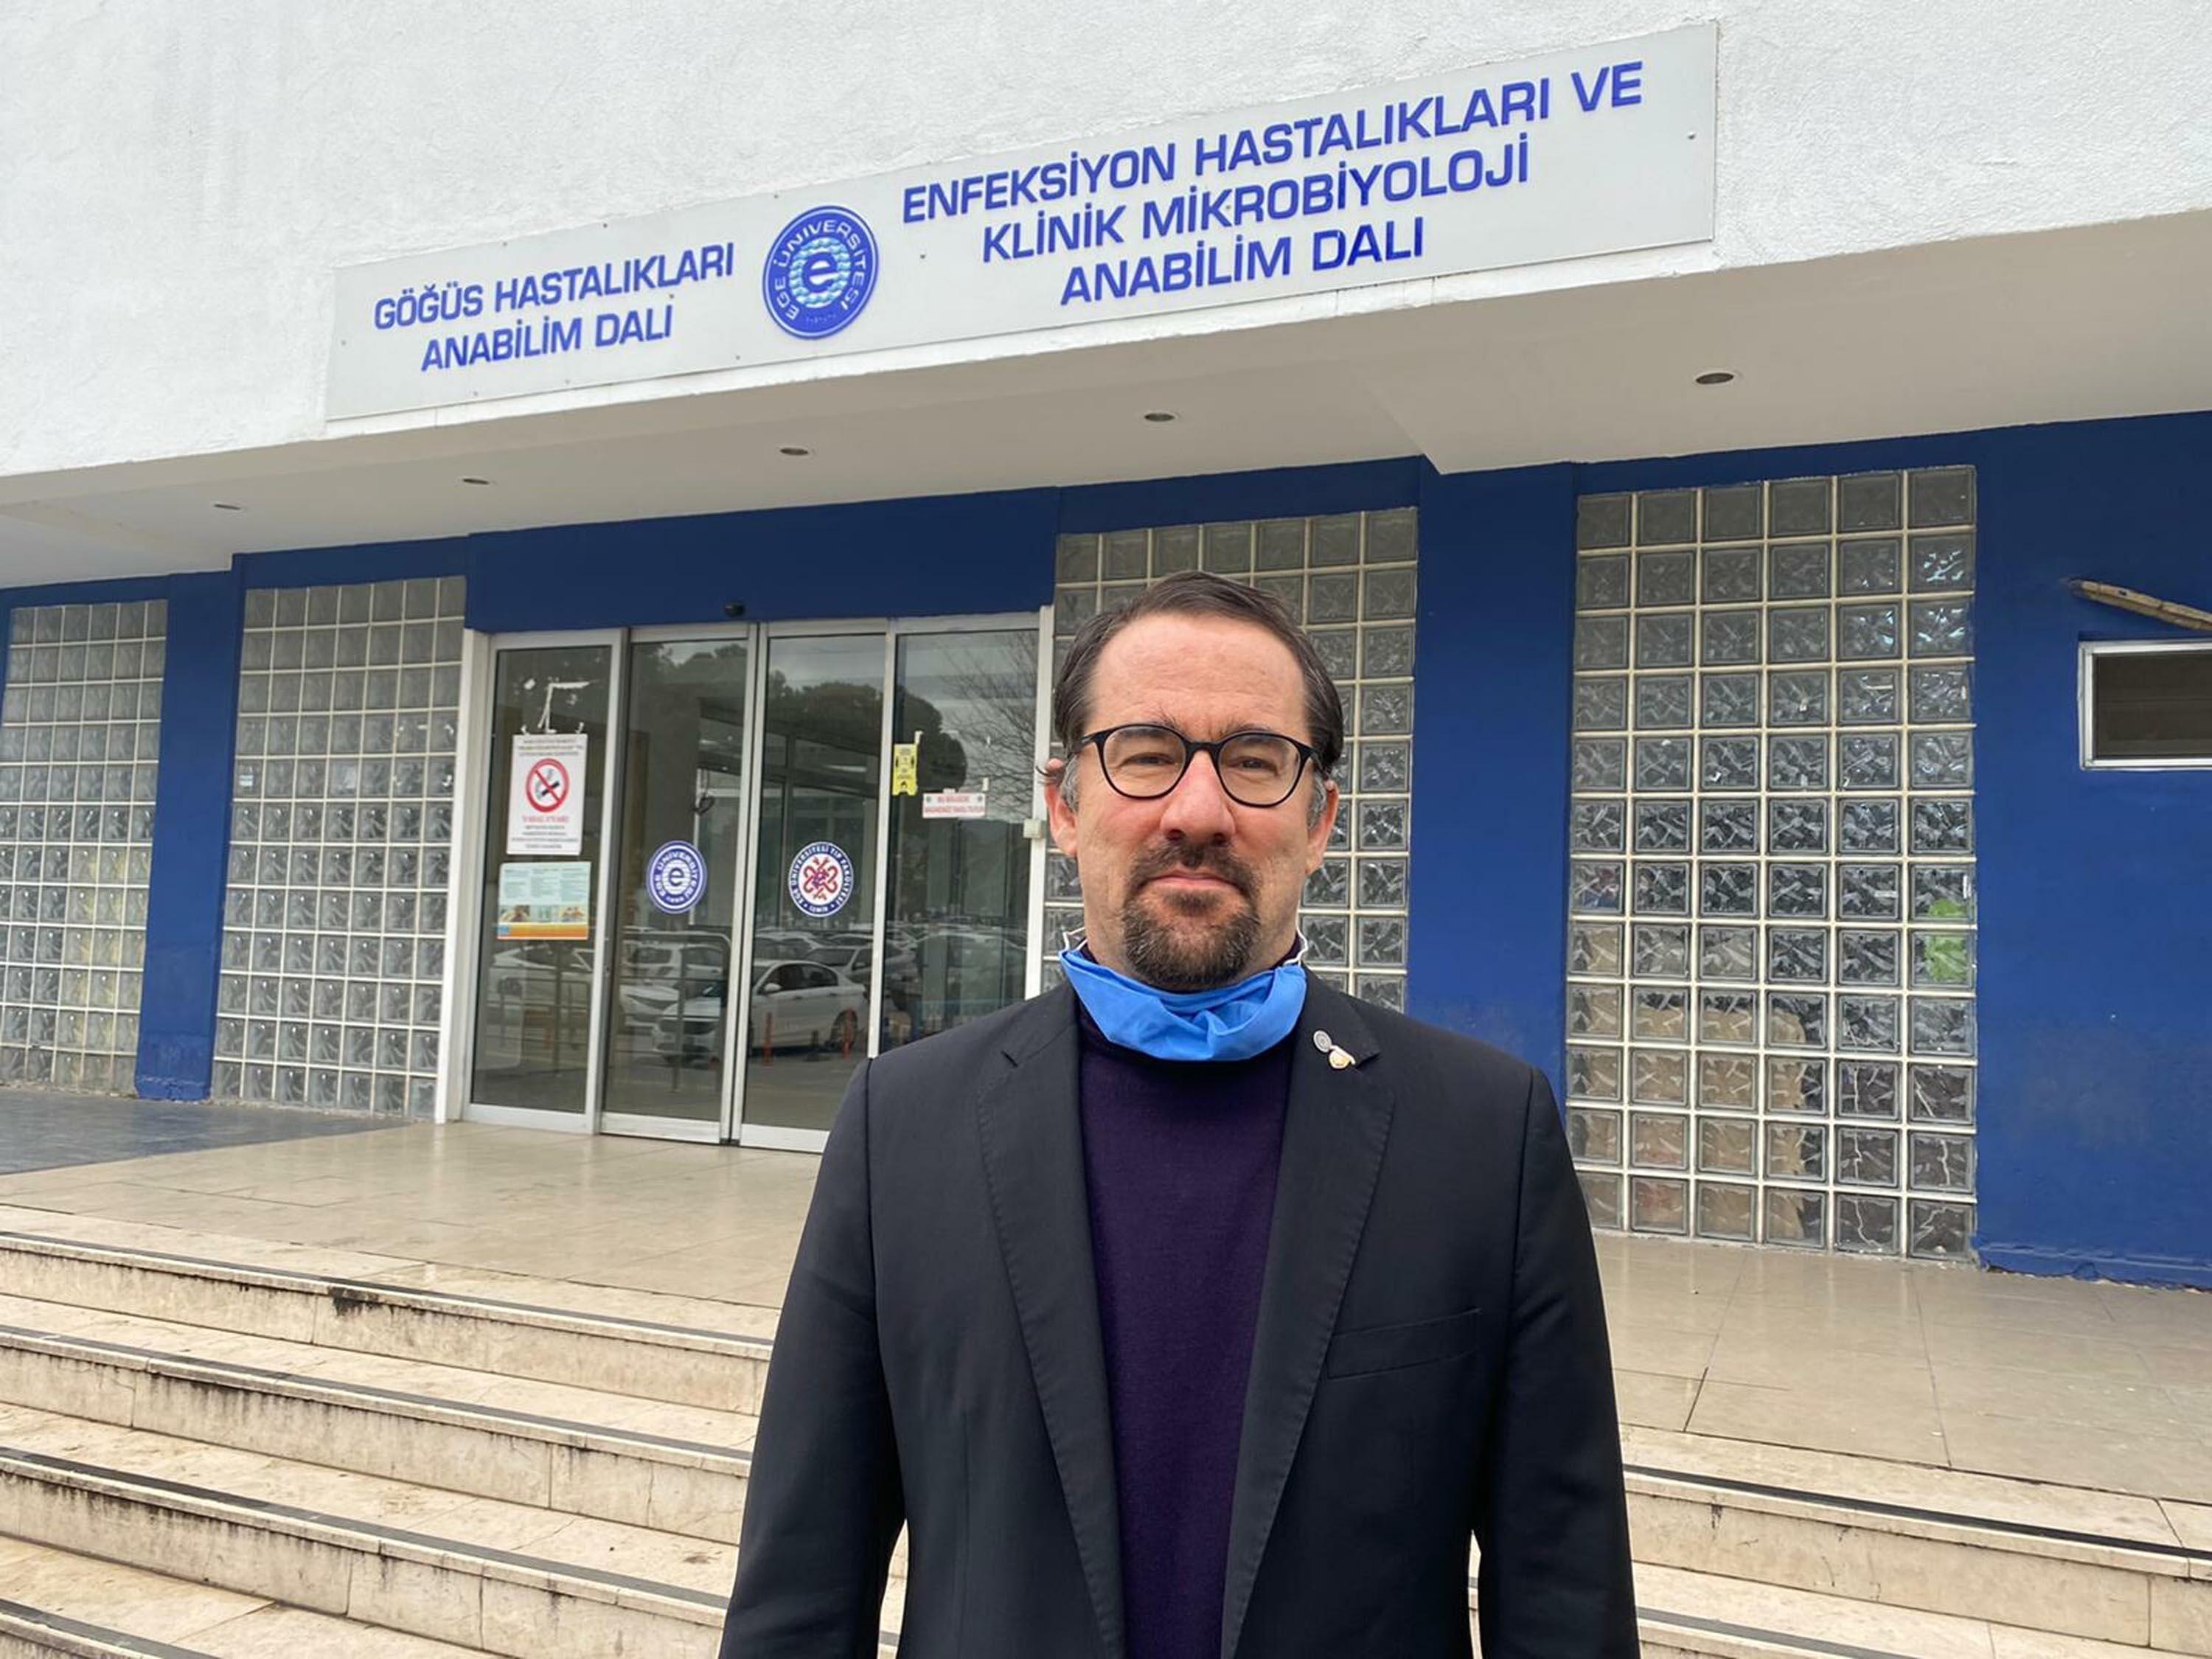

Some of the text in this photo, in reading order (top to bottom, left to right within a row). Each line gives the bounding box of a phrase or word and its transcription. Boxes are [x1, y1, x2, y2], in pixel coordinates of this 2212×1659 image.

[902, 60, 1644, 223] ENFEKSİYON HASTALIKLARI VE
[983, 132, 1529, 264] KLİNİK MİKROBİYOLOJİ
[374, 243, 735, 330] GÖĞÜS HASTALIKLARI
[774, 276, 801, 321] EGE
[1061, 216, 1425, 306] ANABİLİM DALI
[421, 305, 673, 373] ANABİLİM DALI
